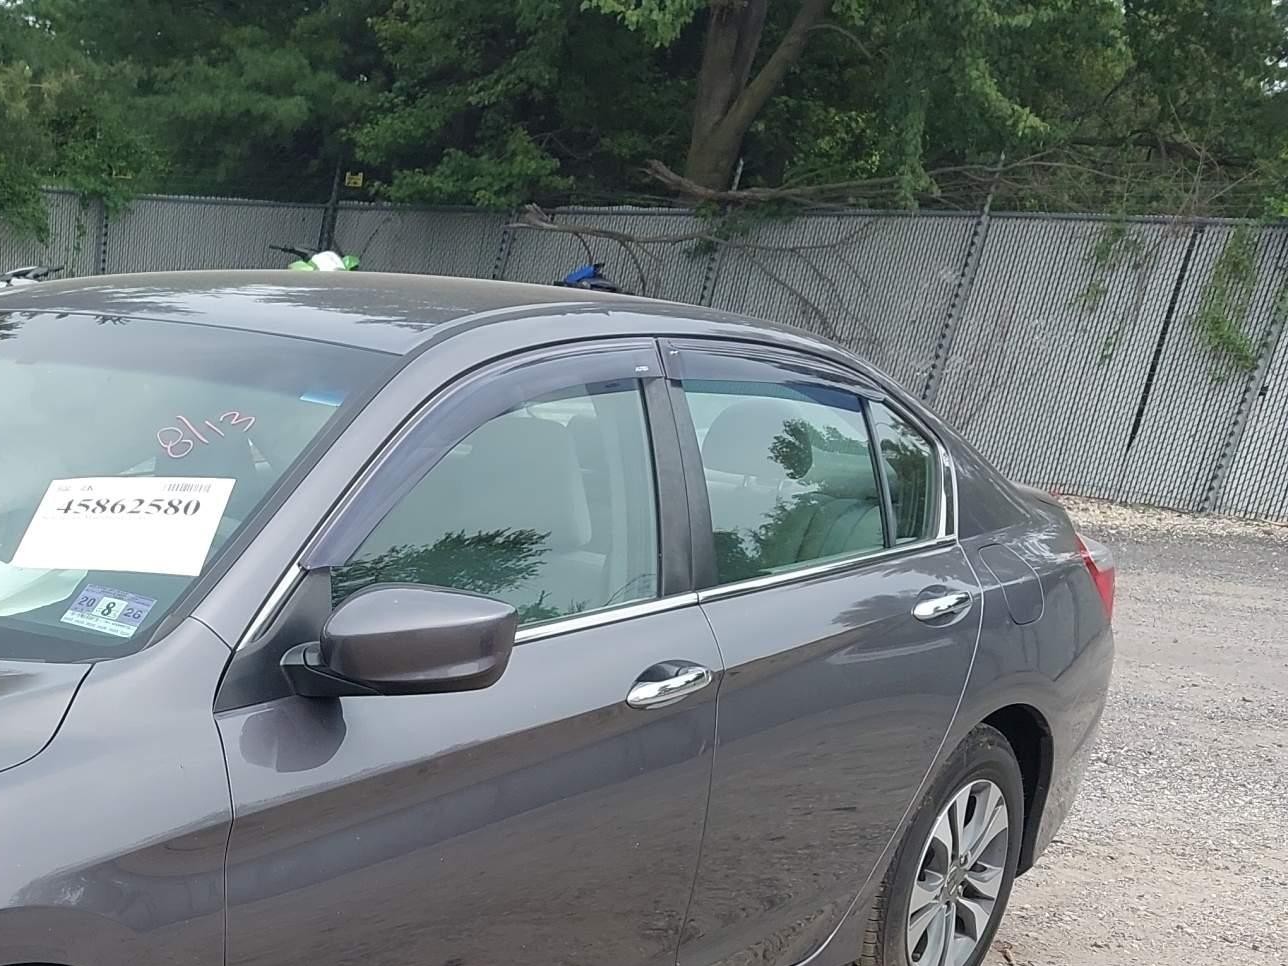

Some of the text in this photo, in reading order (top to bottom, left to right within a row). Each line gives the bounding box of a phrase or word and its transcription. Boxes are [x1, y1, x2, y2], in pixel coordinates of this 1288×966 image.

[156, 411, 256, 459] 8/13
[56, 498, 201, 516] 45862580
[78, 595, 143, 620] 20 8 26
